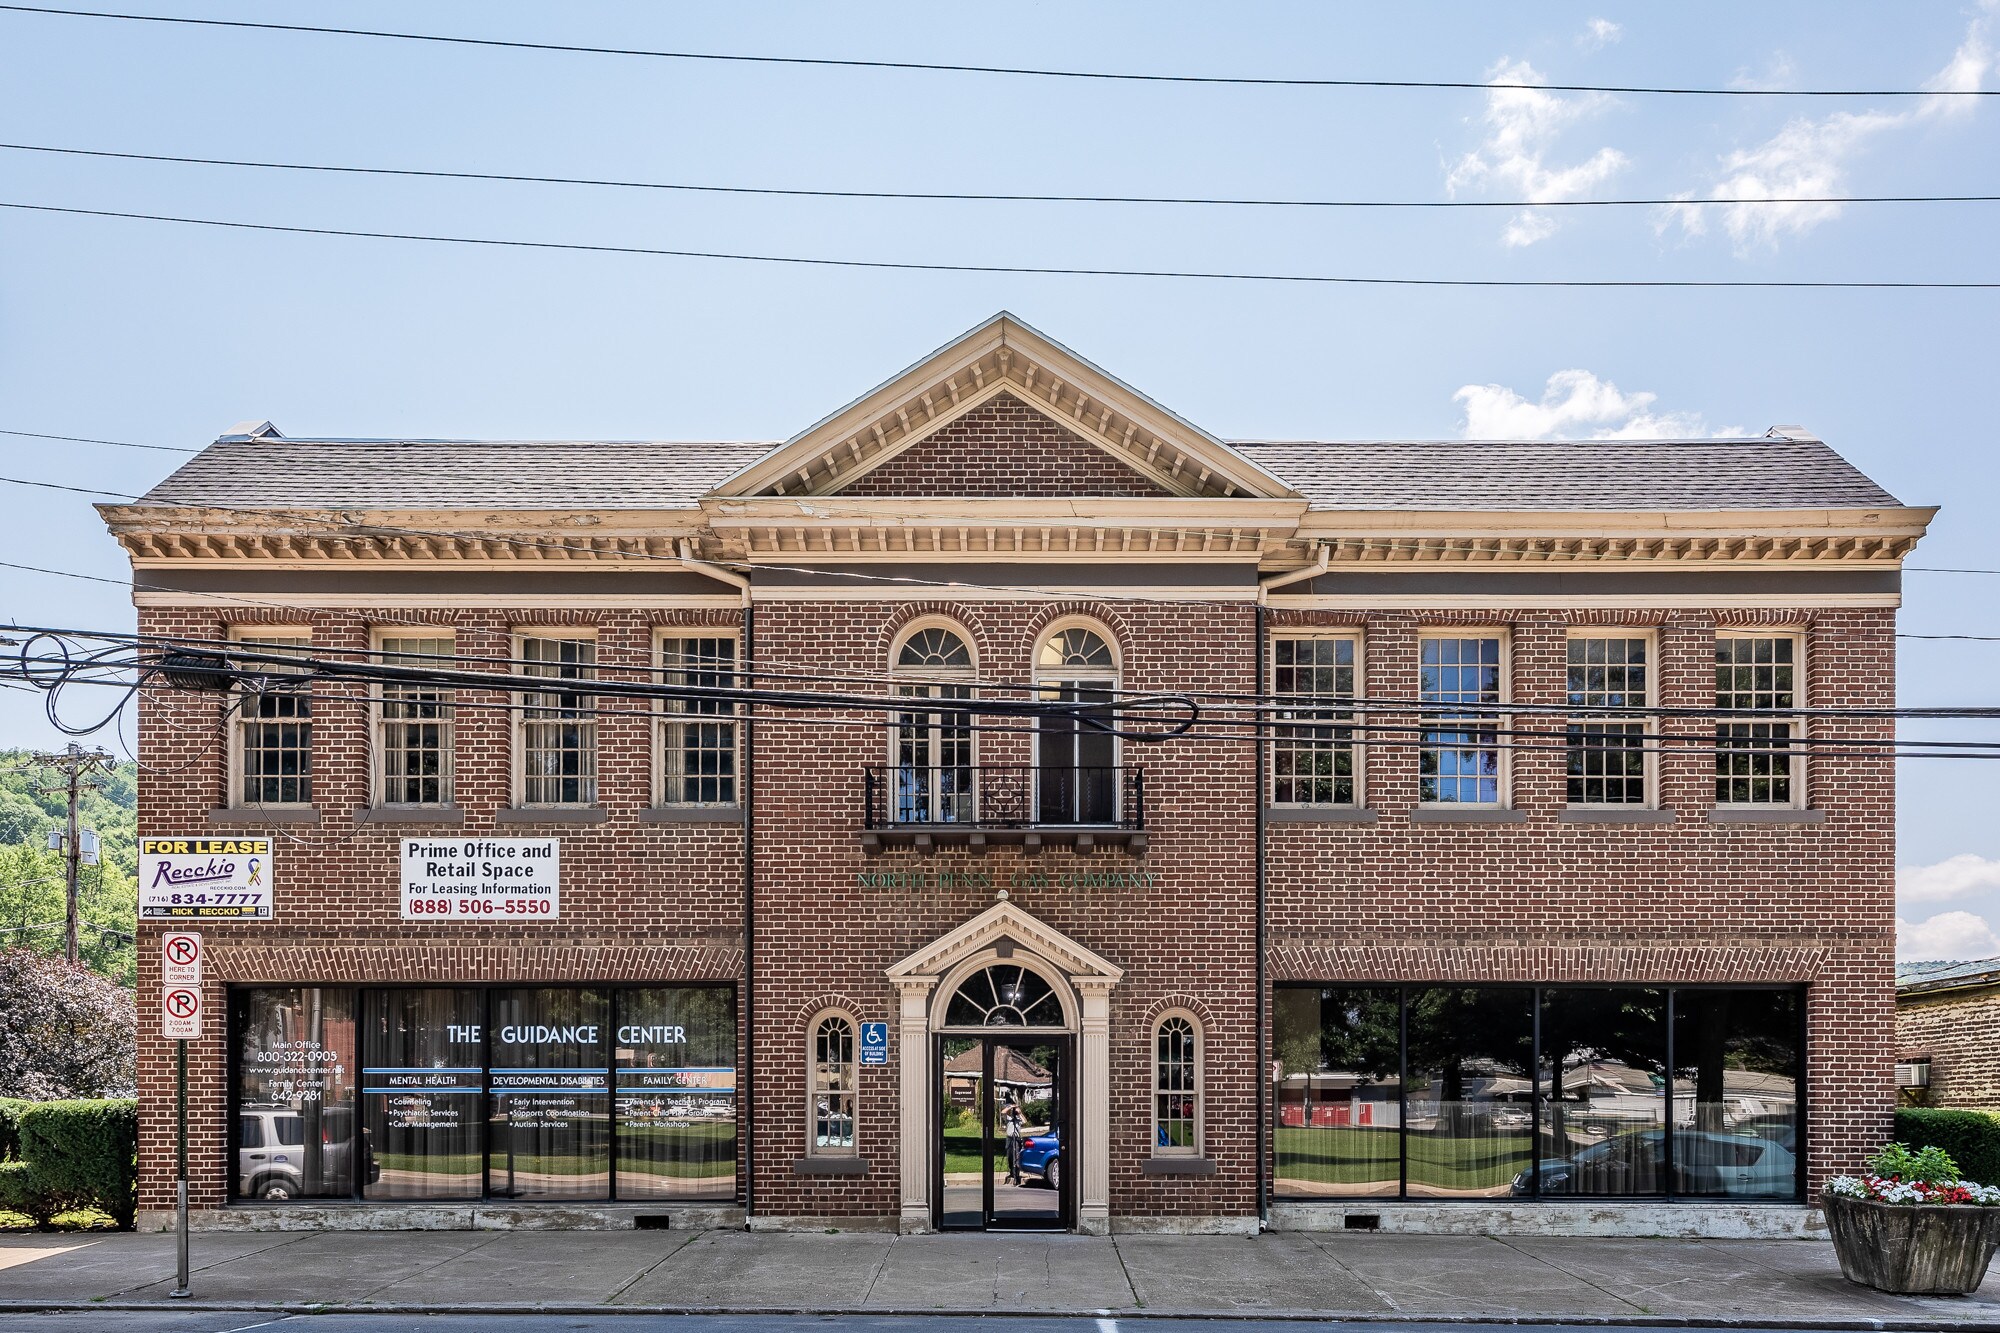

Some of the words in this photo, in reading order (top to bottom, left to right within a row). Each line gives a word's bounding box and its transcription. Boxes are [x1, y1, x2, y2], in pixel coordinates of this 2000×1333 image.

[144, 841, 189, 854] FOR
[196, 841, 268, 854] LEASE
[408, 842, 458, 858] Prime
[464, 842, 516, 858] Office
[522, 843, 551, 858] and
[151, 858, 235, 889] Recckio
[426, 862, 476, 877] Retail
[482, 862, 534, 880] Space
[858, 873, 924, 888] NORTH
[940, 873, 992, 888] PENN
[1010, 873, 1048, 888] GAS
[1060, 873, 1158, 888] COMPANY
[409, 883, 428, 894] For
[432, 883, 478, 896] Leasing
[482, 883, 551, 894] Information
[171, 894, 262, 904] 834-7777
[409, 899, 452, 915] (888)
[458, 900, 551, 914] 506-5550
[447, 1026, 481, 1043] THE
[501, 1026, 598, 1044] GUIDANCE
[618, 1026, 687, 1044] CENTER
[257, 1051, 337, 1062] 800-322-0905
[249, 1067, 344, 1075] www.guidancecenter.nt
[269, 1080, 294, 1089] Family
[493, 1077, 558, 1085] DEVELOPMENTAL
[271, 1091, 321, 1100] 642-9281
[393, 1098, 431, 1106] Counseling
